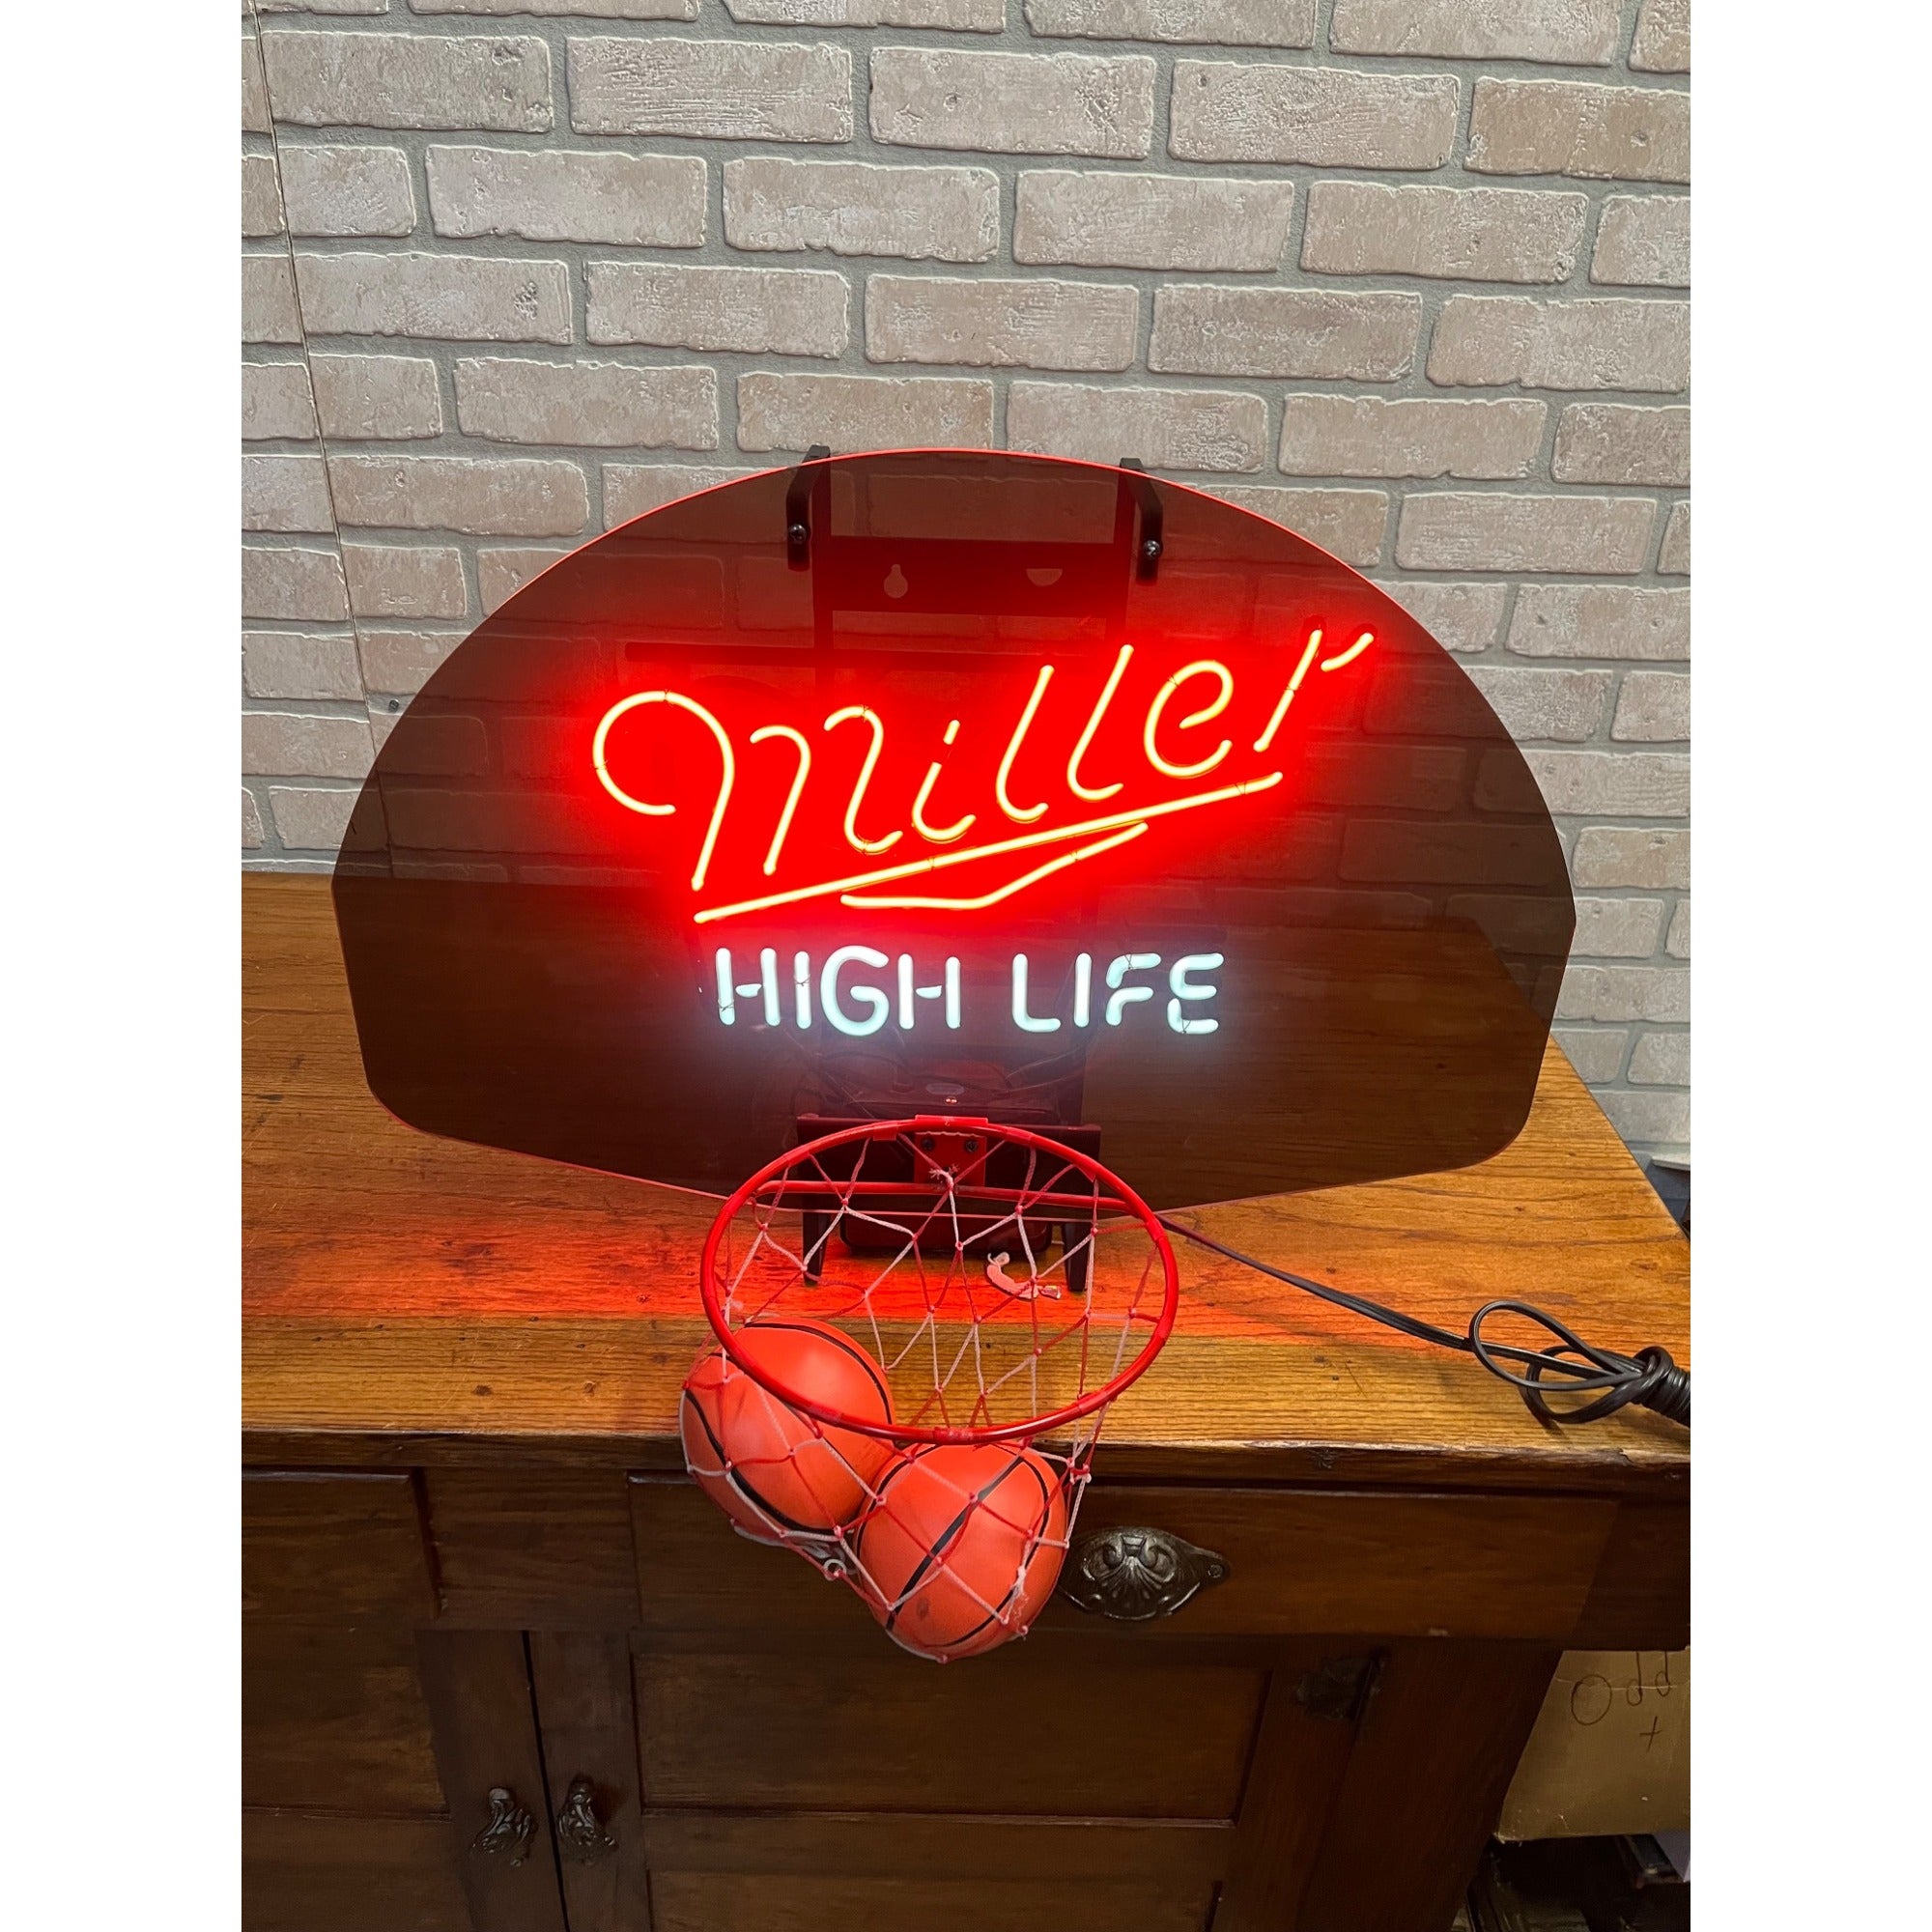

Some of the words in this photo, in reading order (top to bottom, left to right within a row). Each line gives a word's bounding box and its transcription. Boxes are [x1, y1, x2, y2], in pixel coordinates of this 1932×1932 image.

[592, 628, 1375, 891] Miller
[715, 946, 962, 1036] HIGH
[1011, 952, 1225, 1035] LIFE
